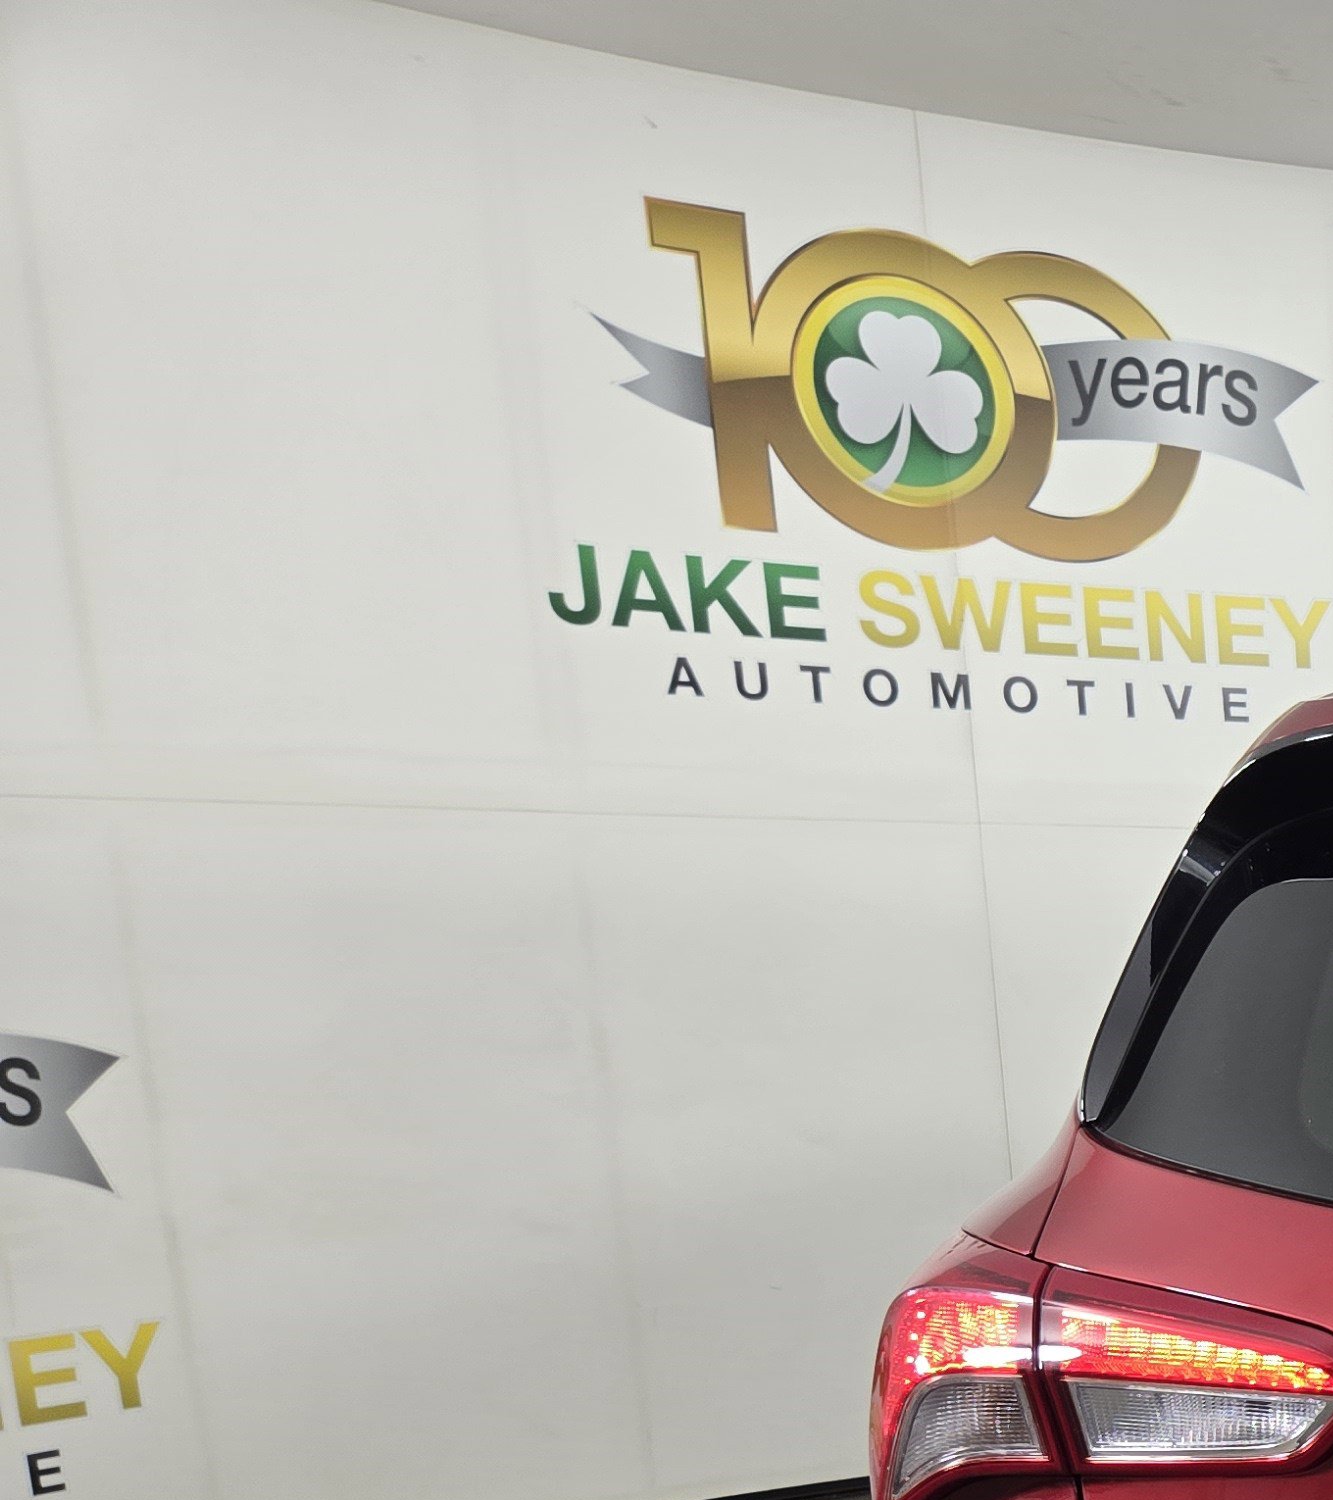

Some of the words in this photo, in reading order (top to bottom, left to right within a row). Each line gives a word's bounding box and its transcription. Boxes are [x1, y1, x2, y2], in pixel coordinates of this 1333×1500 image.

[1068, 352, 1259, 427] years
[548, 543, 828, 642] JAKE
[858, 569, 1331, 670] SWEENEY
[666, 655, 1251, 723] AUTOMOTIVE
